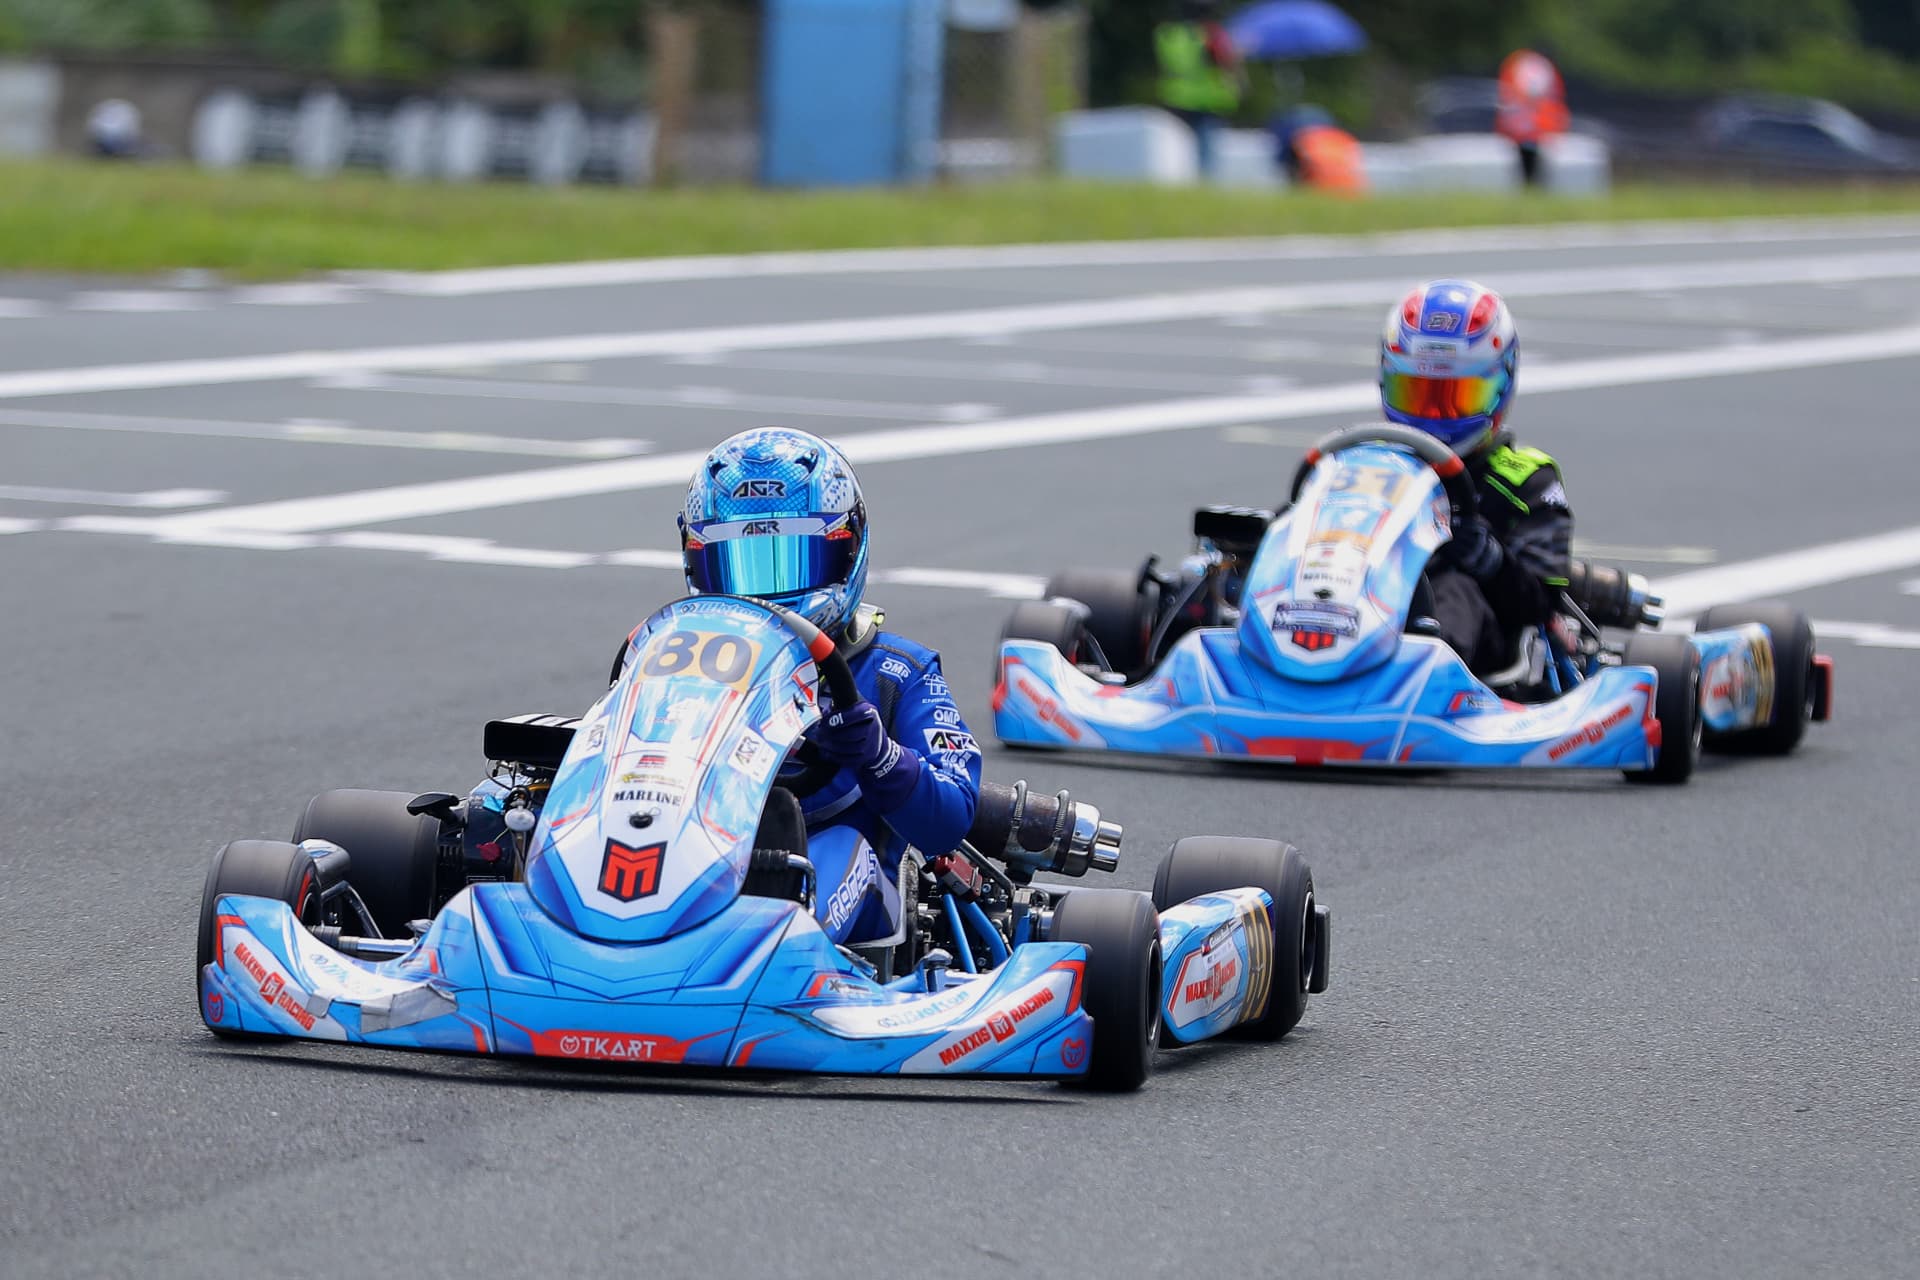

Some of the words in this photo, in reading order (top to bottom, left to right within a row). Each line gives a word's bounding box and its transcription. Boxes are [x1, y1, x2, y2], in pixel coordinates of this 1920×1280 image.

[643, 630, 752, 684] 80
[881, 659, 909, 679] OMP
[933, 709, 960, 726] OMP
[612, 789, 682, 806] MARLINE
[939, 1026, 992, 1066] MAXXIS
[1009, 987, 1054, 1022] RACING
